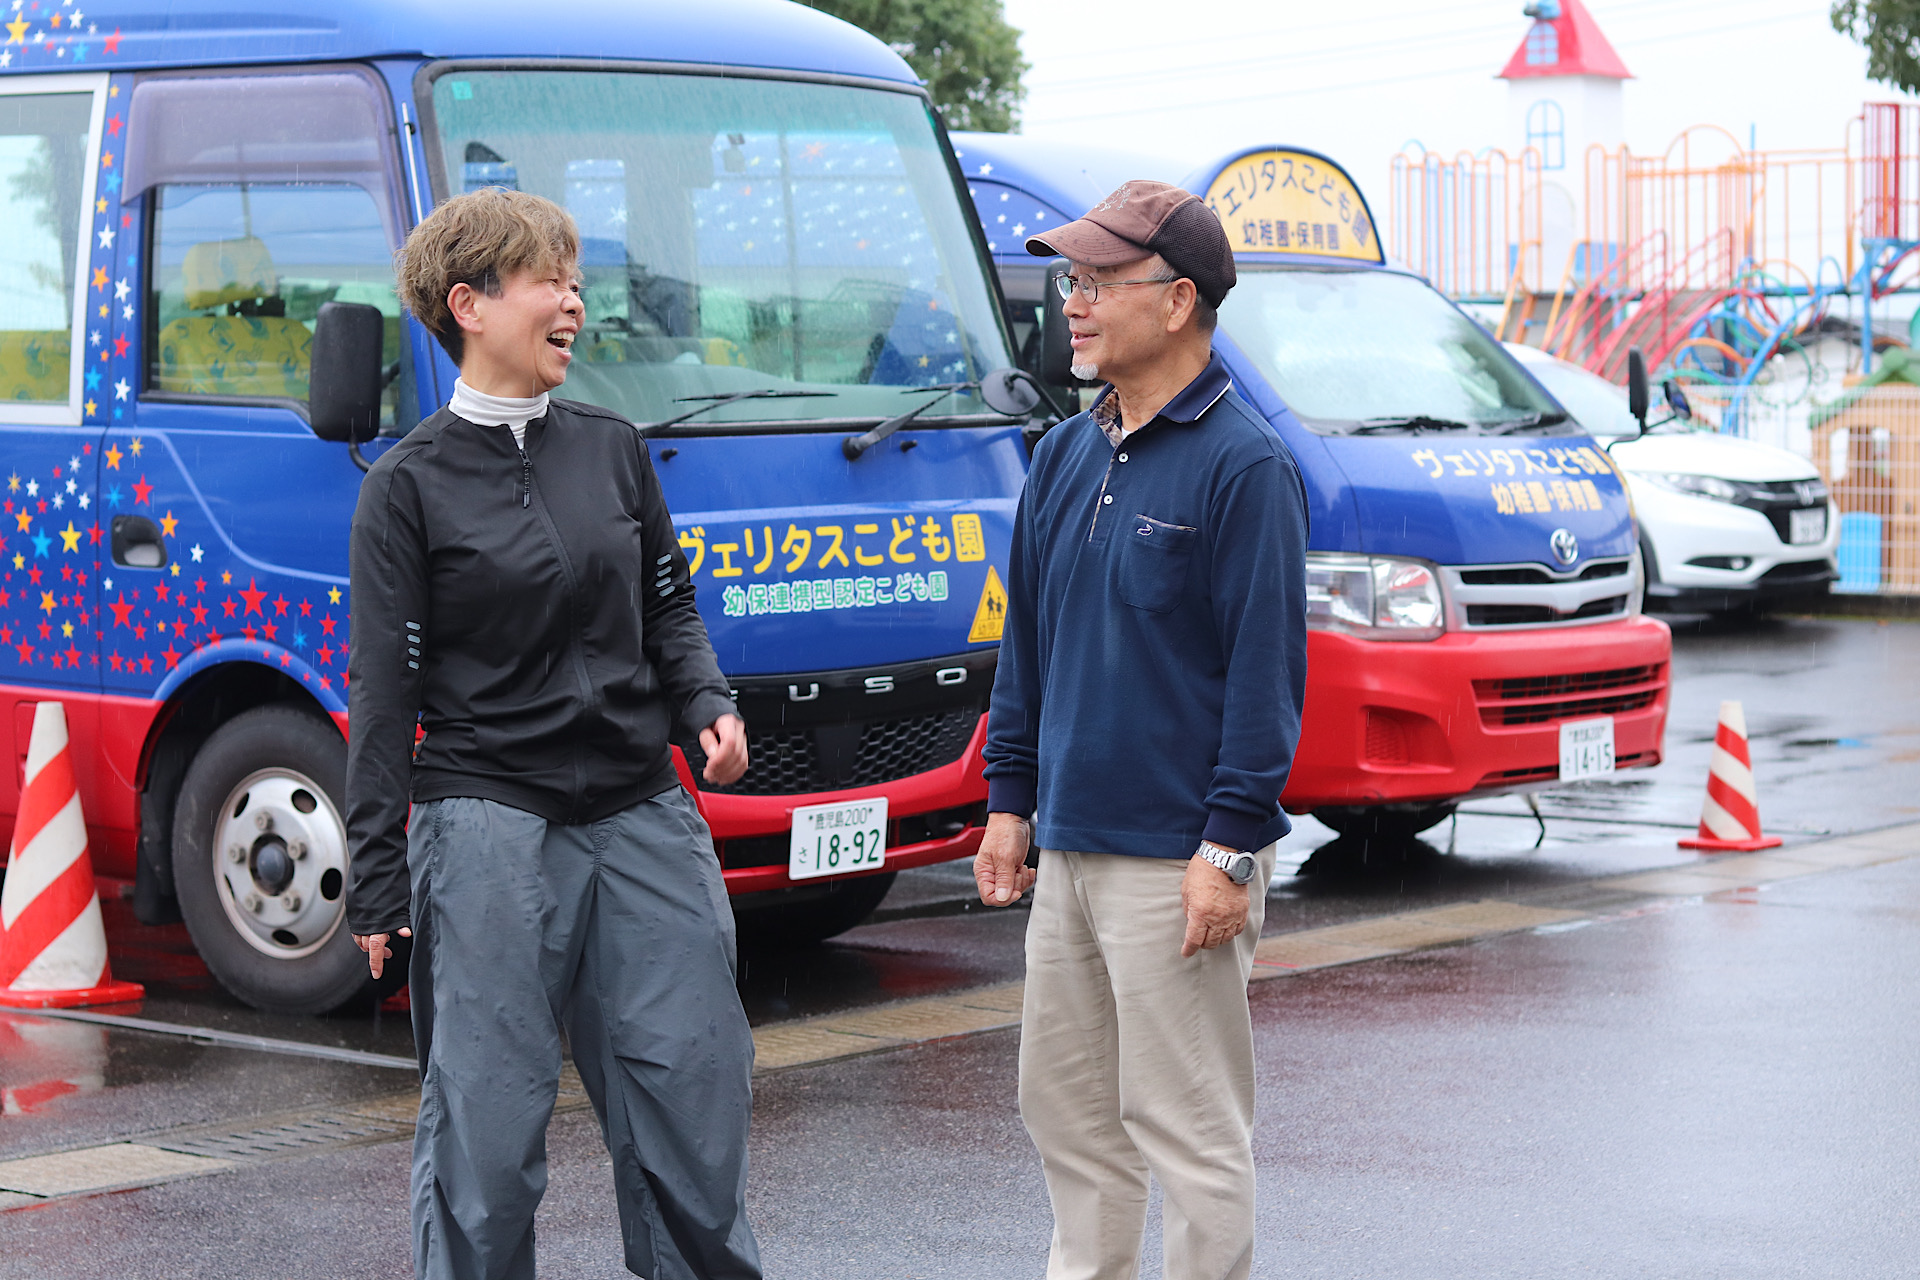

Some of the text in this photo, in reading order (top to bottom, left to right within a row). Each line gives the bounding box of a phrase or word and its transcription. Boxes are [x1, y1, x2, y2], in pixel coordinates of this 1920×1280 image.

[677, 513, 986, 578] ヴェリタスこども園
[722, 571, 948, 616] 幼保連携型認定こども園
[816, 829, 880, 870] 18-92
